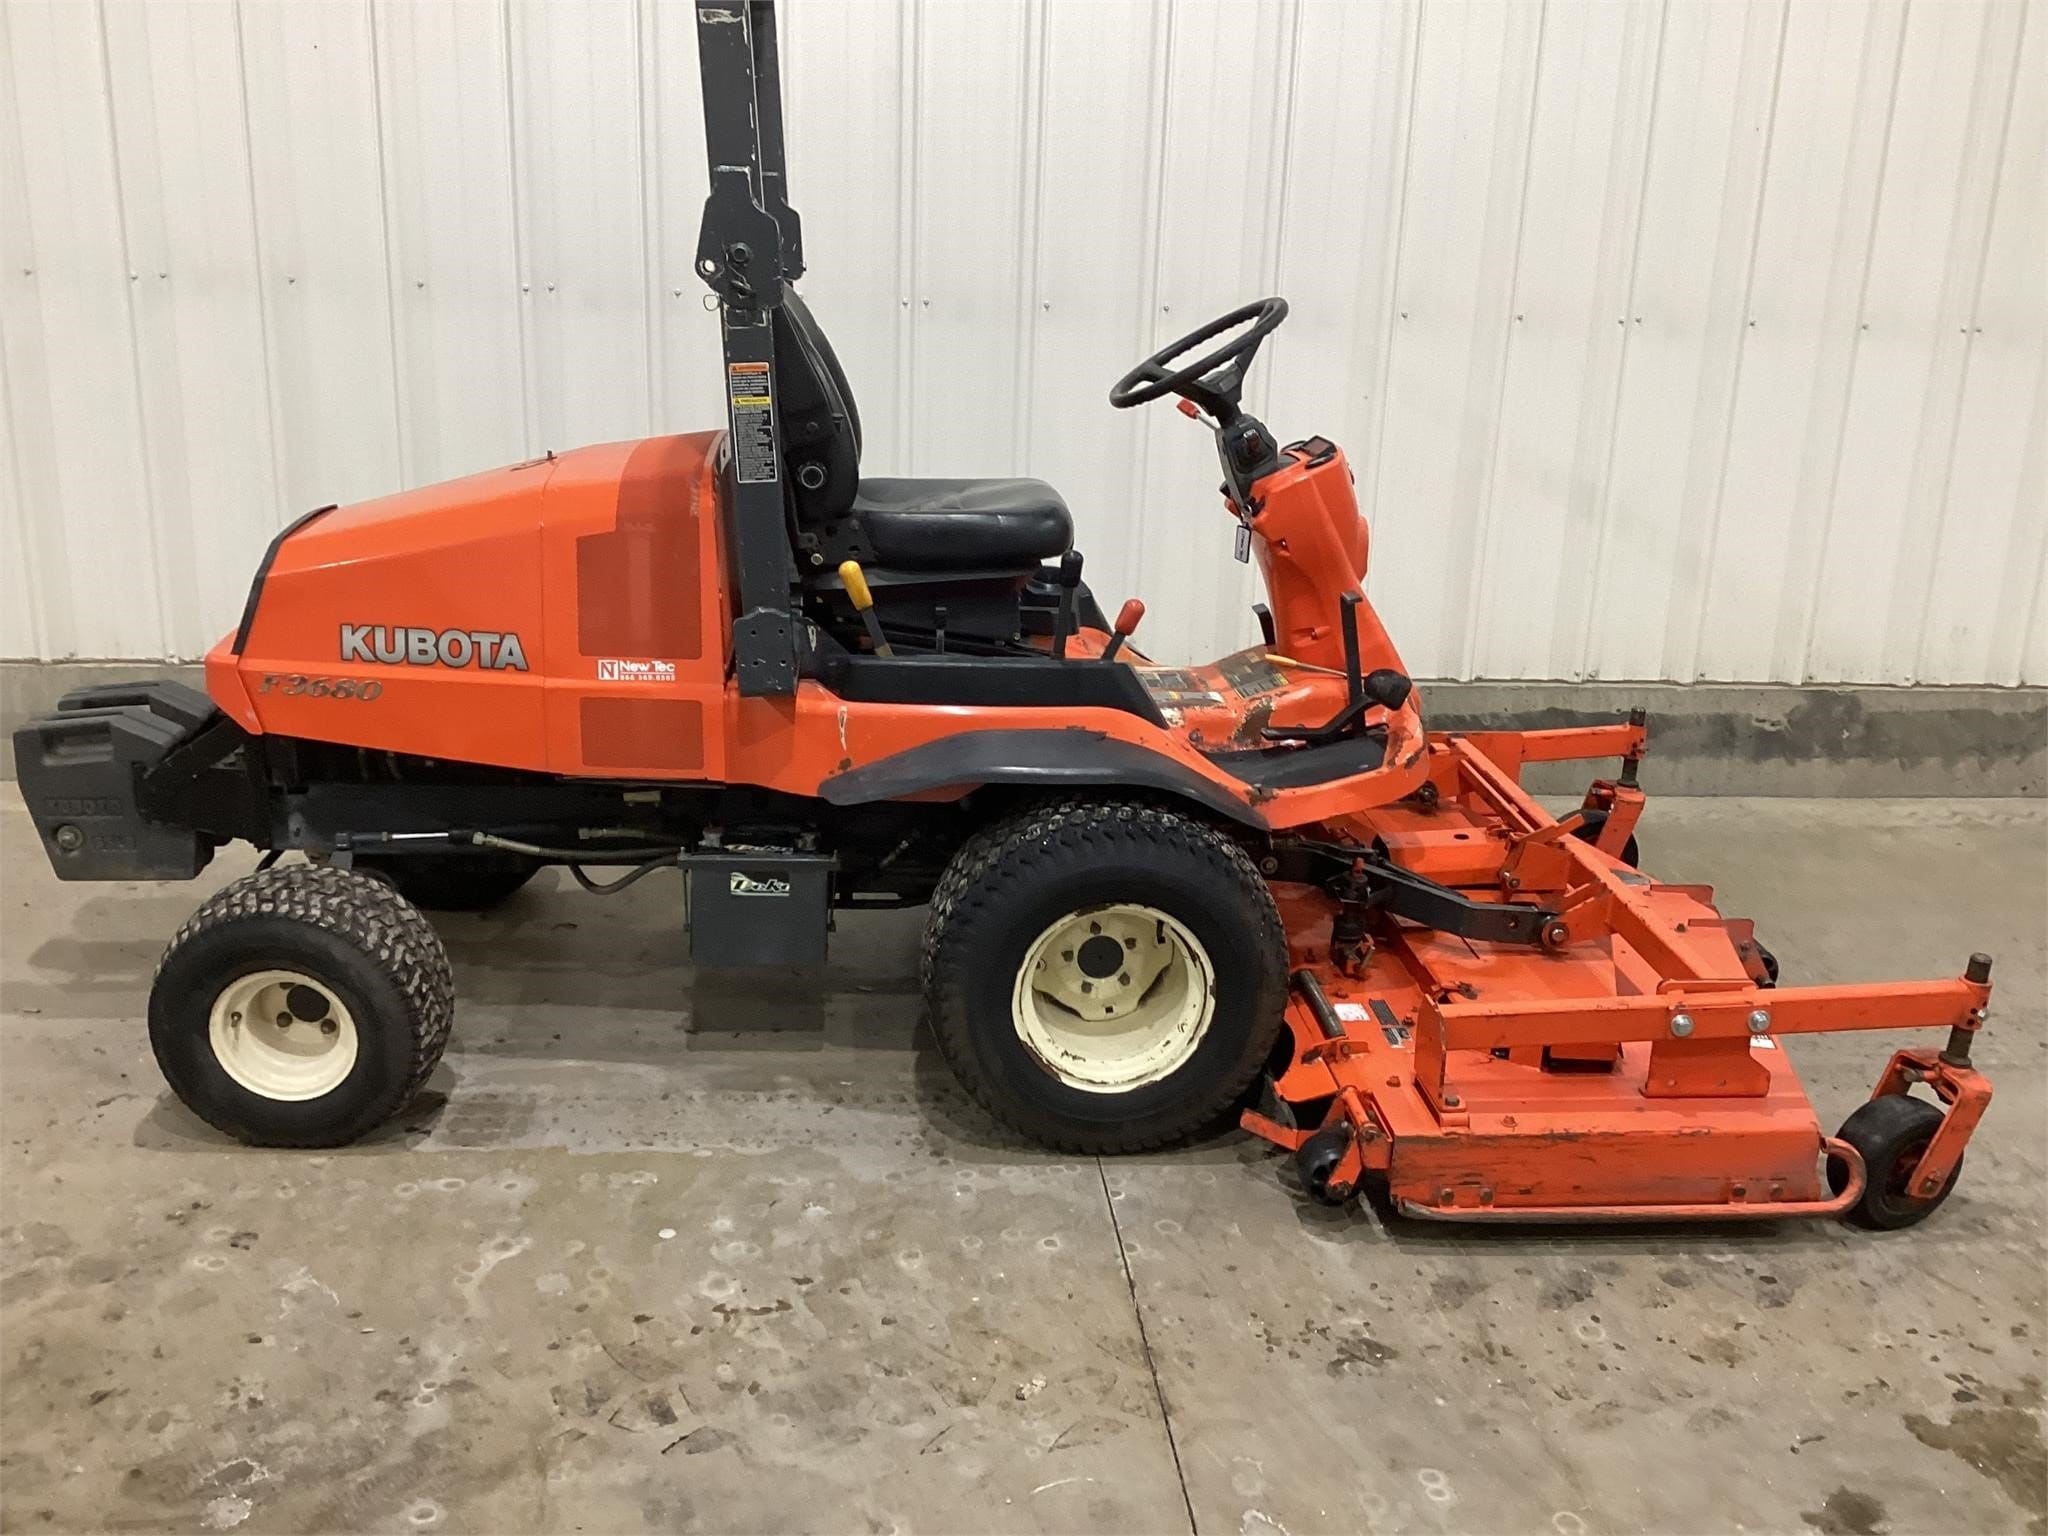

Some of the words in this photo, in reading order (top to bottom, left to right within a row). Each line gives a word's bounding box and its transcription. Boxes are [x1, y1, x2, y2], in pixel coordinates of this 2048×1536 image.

[340, 624, 528, 671] KUBOTA
[619, 660, 650, 672] New
[651, 660, 676, 672] Tec
[258, 672, 382, 701] F3680
